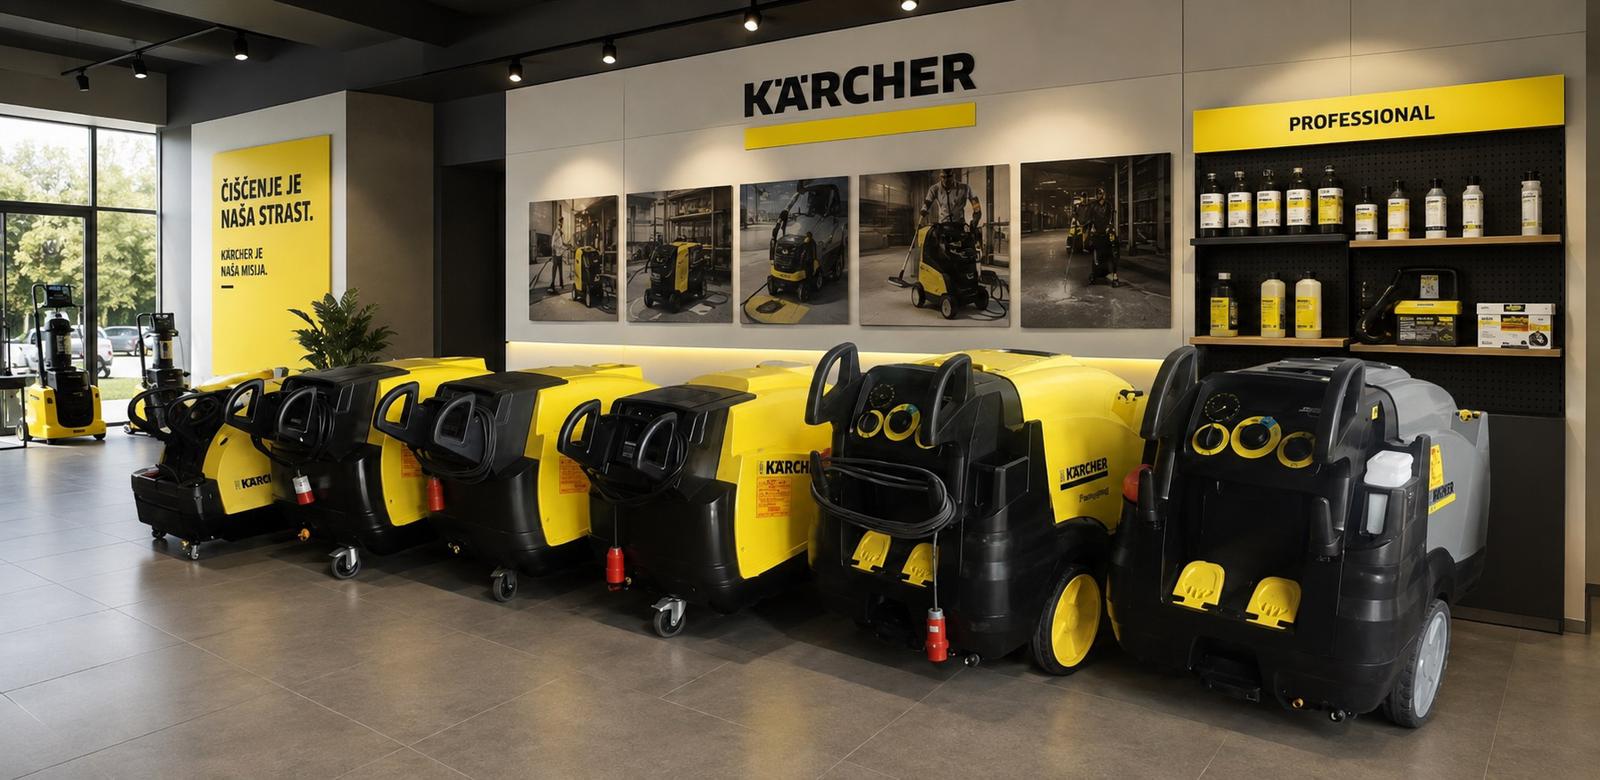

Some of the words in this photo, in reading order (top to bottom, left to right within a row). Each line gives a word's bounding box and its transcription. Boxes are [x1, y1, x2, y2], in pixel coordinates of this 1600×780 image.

[744, 52, 976, 118] KÄRCHER
[1289, 104, 1435, 132] PROFESSIONAL
[221, 175, 282, 202] ČIŠČENJE
[286, 173, 302, 195] JE
[221, 203, 255, 229] NAŠA
[259, 200, 314, 225] STRAST.
[221, 248, 253, 261] KÄRCHER
[255, 247, 263, 259] JE
[221, 263, 239, 277] NAŠA
[241, 264, 268, 276] MISIJA.
[766, 460, 811, 475] KÄRCH
[1066, 457, 1108, 481] KÄRCHER
